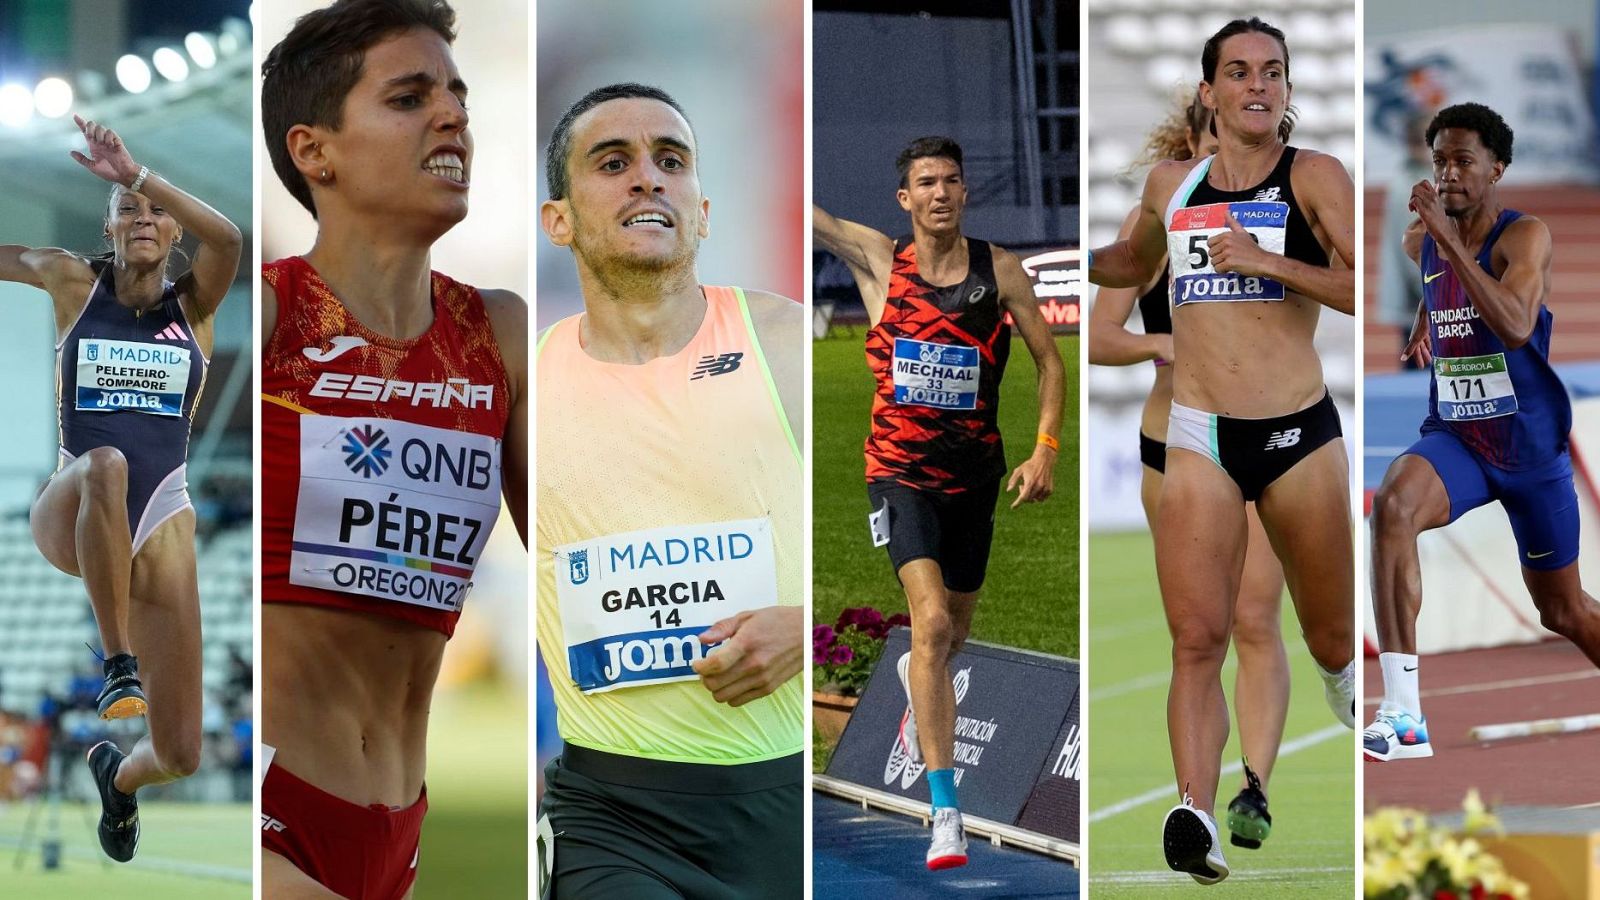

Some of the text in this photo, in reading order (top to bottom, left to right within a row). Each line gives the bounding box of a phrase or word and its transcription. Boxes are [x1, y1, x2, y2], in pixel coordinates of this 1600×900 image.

[1243, 211, 1281, 219] MADRID
[1437, 323, 1474, 339] BARÇA
[110, 347, 182, 365] MADRID
[95, 365, 170, 378] PELETEIRO-
[897, 361, 974, 381] MECHAAL
[1450, 362, 1493, 372] IBERDROLA
[97, 378, 167, 391] COMPAORE
[308, 372, 494, 409] ESPAÑA
[926, 379, 943, 390] 33
[1449, 378, 1486, 400] 171
[401, 438, 492, 490] QNB
[339, 493, 482, 565] PÉREZ
[610, 533, 754, 573] MADRID
[601, 580, 725, 613] GARCIA
[650, 608, 682, 629] 14
[603, 633, 731, 682] Jom
